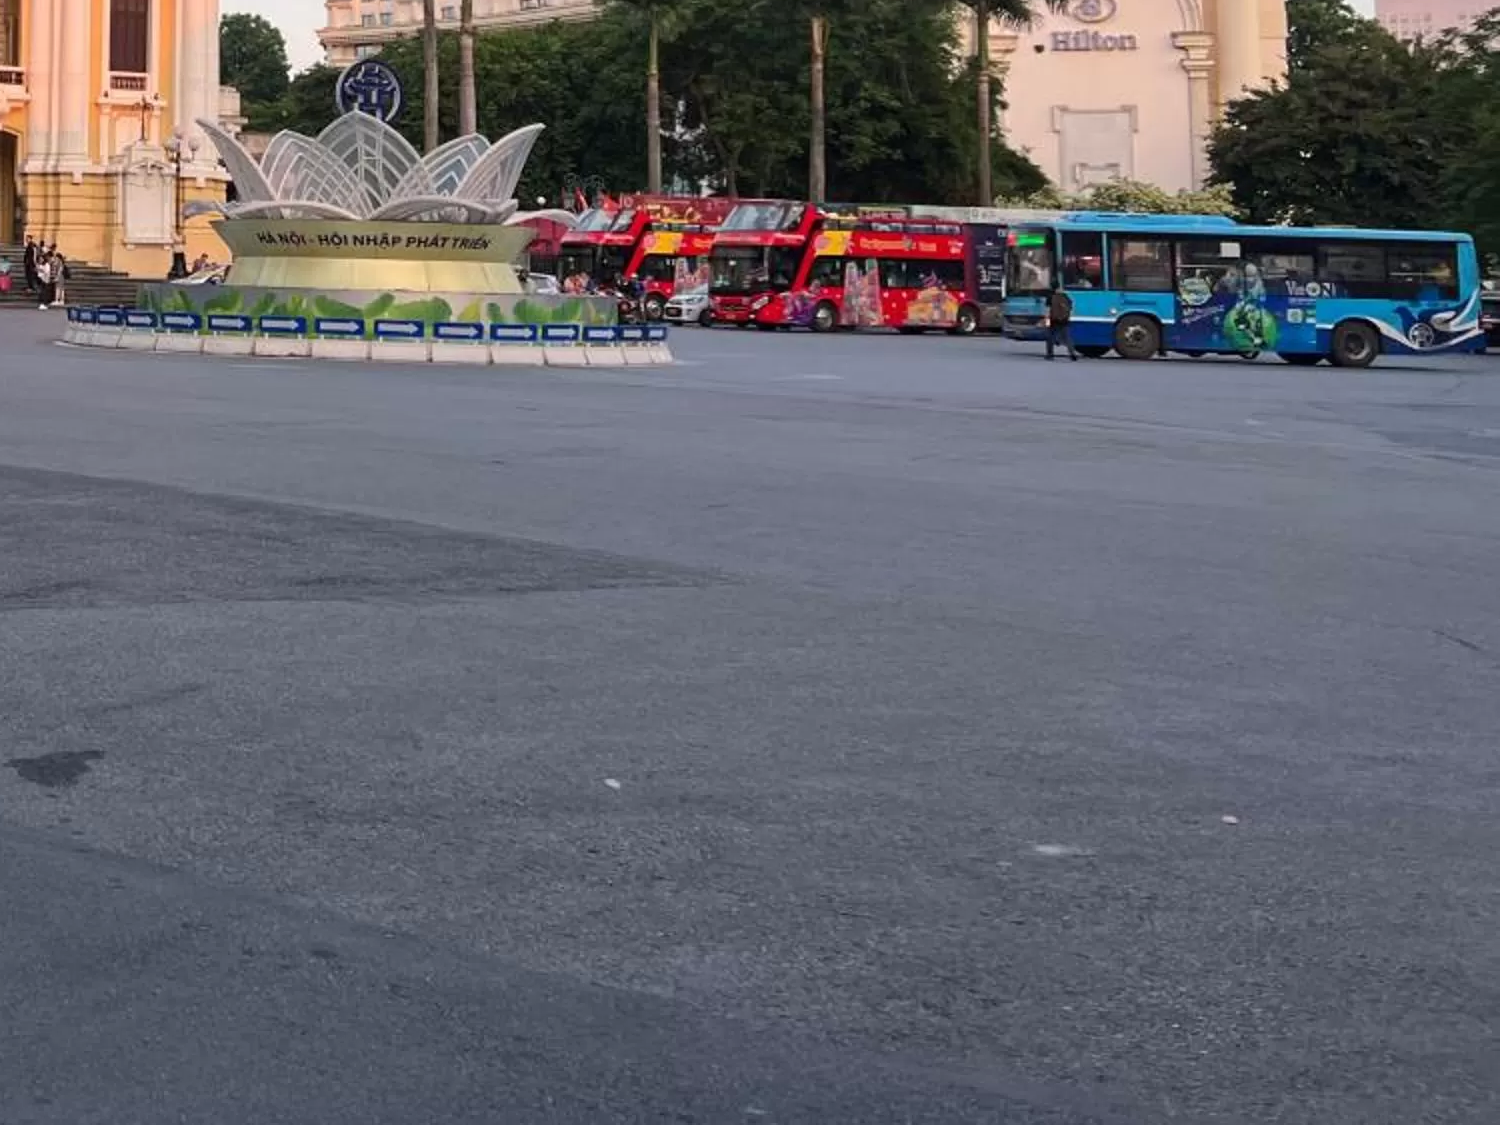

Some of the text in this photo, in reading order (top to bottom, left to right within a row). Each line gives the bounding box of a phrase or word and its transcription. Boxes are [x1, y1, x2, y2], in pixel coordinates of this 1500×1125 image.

[1051, 29, 1138, 51] Hilton
[318, 231, 348, 249] HỘI
[353, 232, 401, 249] NHẬP
[405, 233, 451, 248] PHÁT
